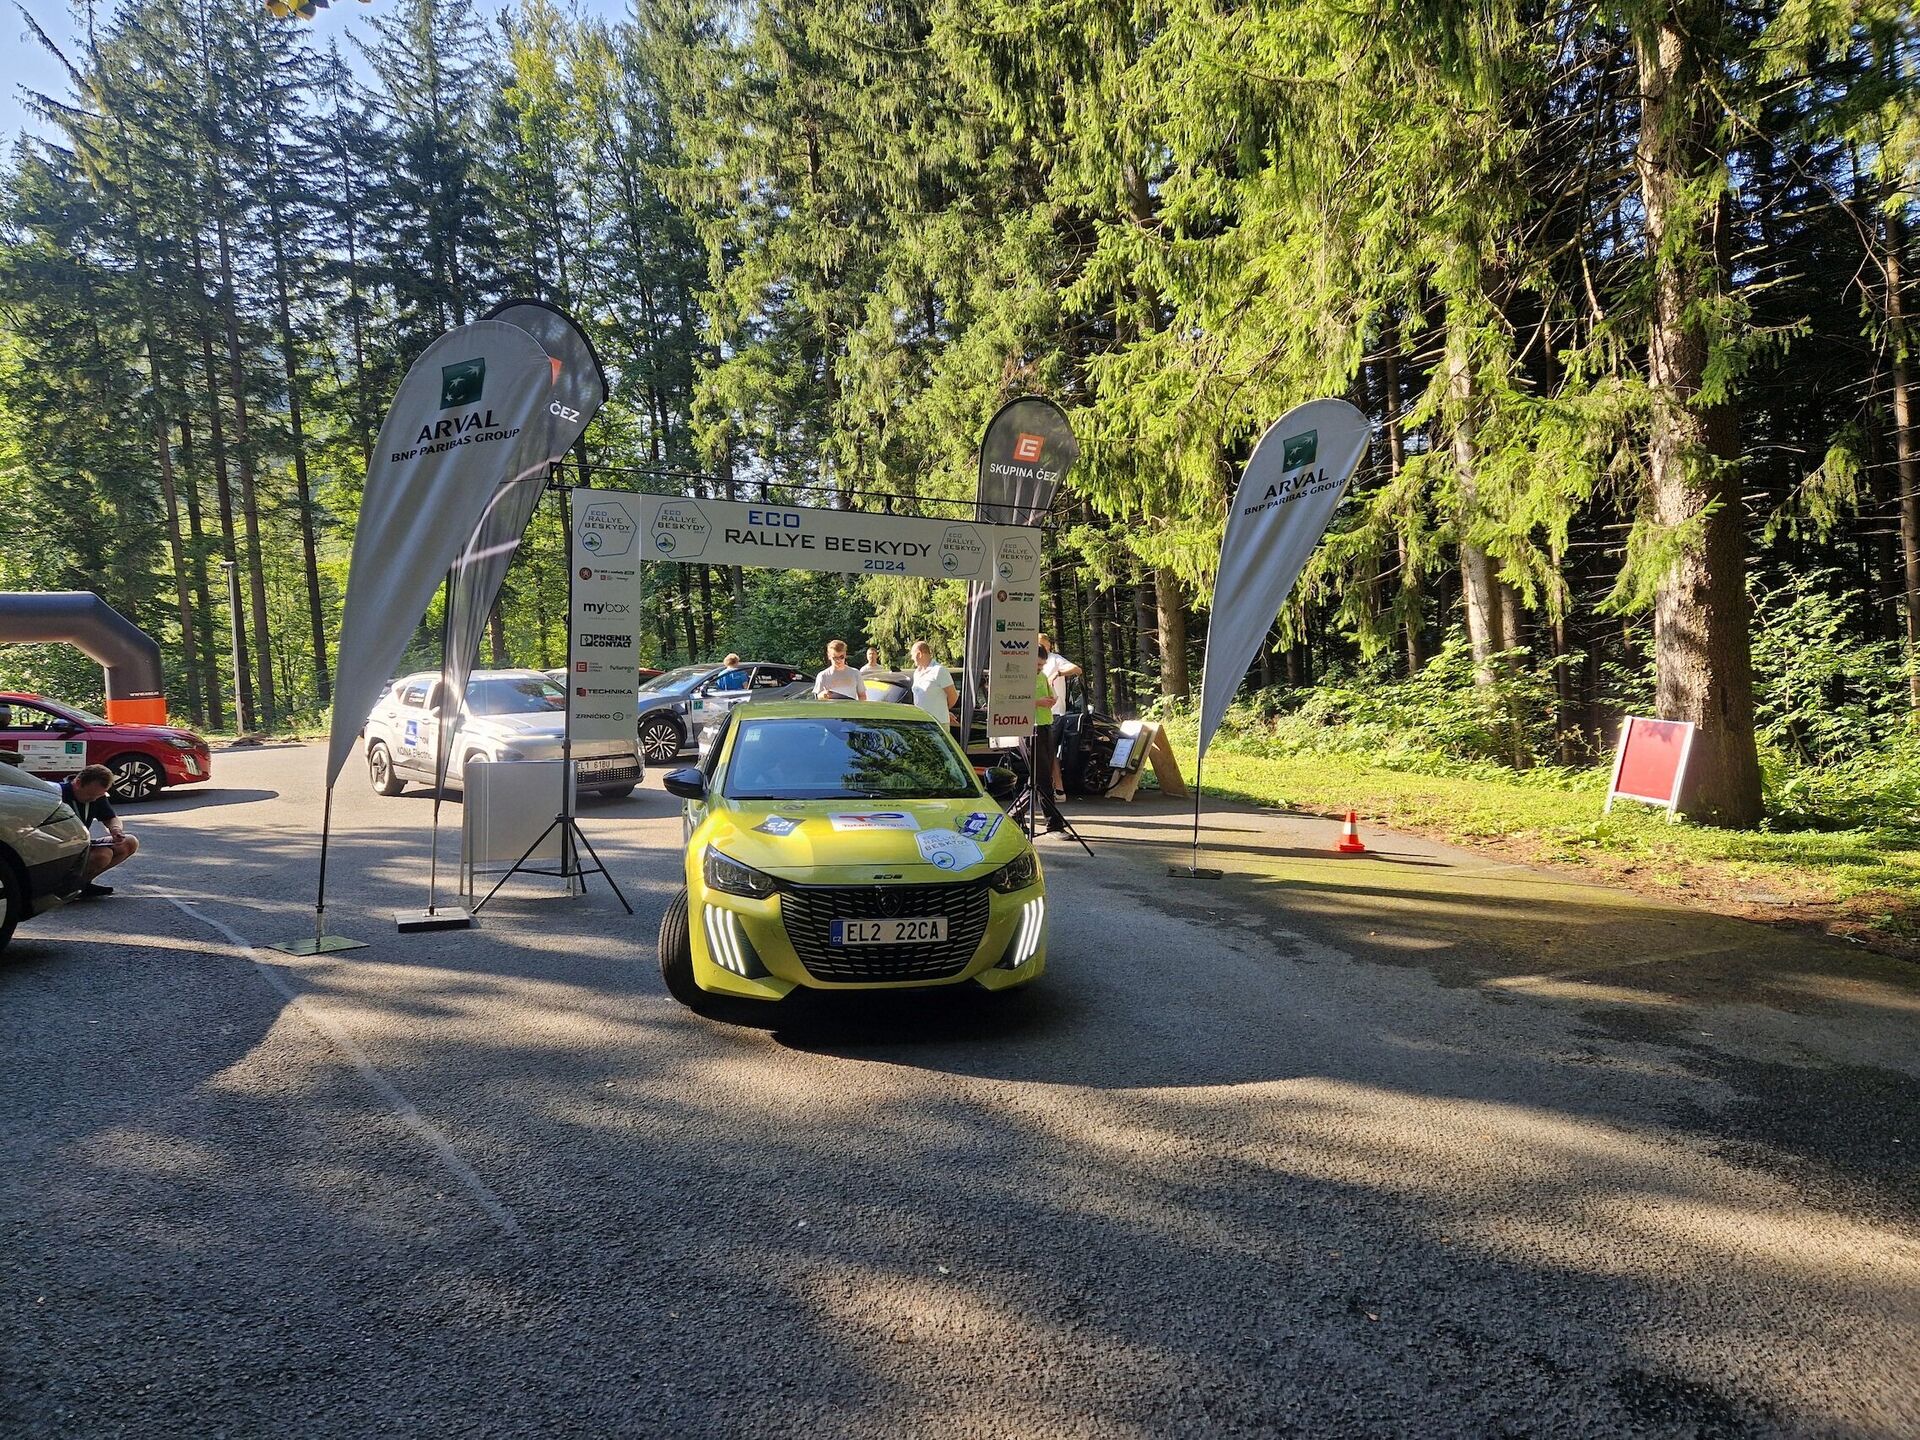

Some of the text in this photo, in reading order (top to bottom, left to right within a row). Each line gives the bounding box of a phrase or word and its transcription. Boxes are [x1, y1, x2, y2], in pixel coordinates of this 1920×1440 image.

[550, 400, 580, 423] ČEZ
[416, 410, 499, 444] ARVAL
[391, 428, 520, 462] BNP PARIBAS GROUP
[990, 463, 1058, 482] SKUPINA ČEZ
[1264, 468, 1329, 500] ARVAL
[1244, 478, 1346, 515] BNP PARIBAS GROUP
[584, 523, 630, 531] BESKYDY
[588, 516, 622, 524] RALLYE
[657, 522, 705, 531] BESKYDY
[661, 515, 697, 524] RALLYE
[748, 510, 800, 528] ECO
[725, 528, 931, 557] RALLYE BESKYDY
[943, 544, 981, 552] BESKYDY
[864, 559, 905, 571] 2024
[583, 602, 630, 614] mybox
[71, 743, 77, 752] 5
[847, 923, 880, 941] EL2
[896, 921, 939, 940] 22CA
